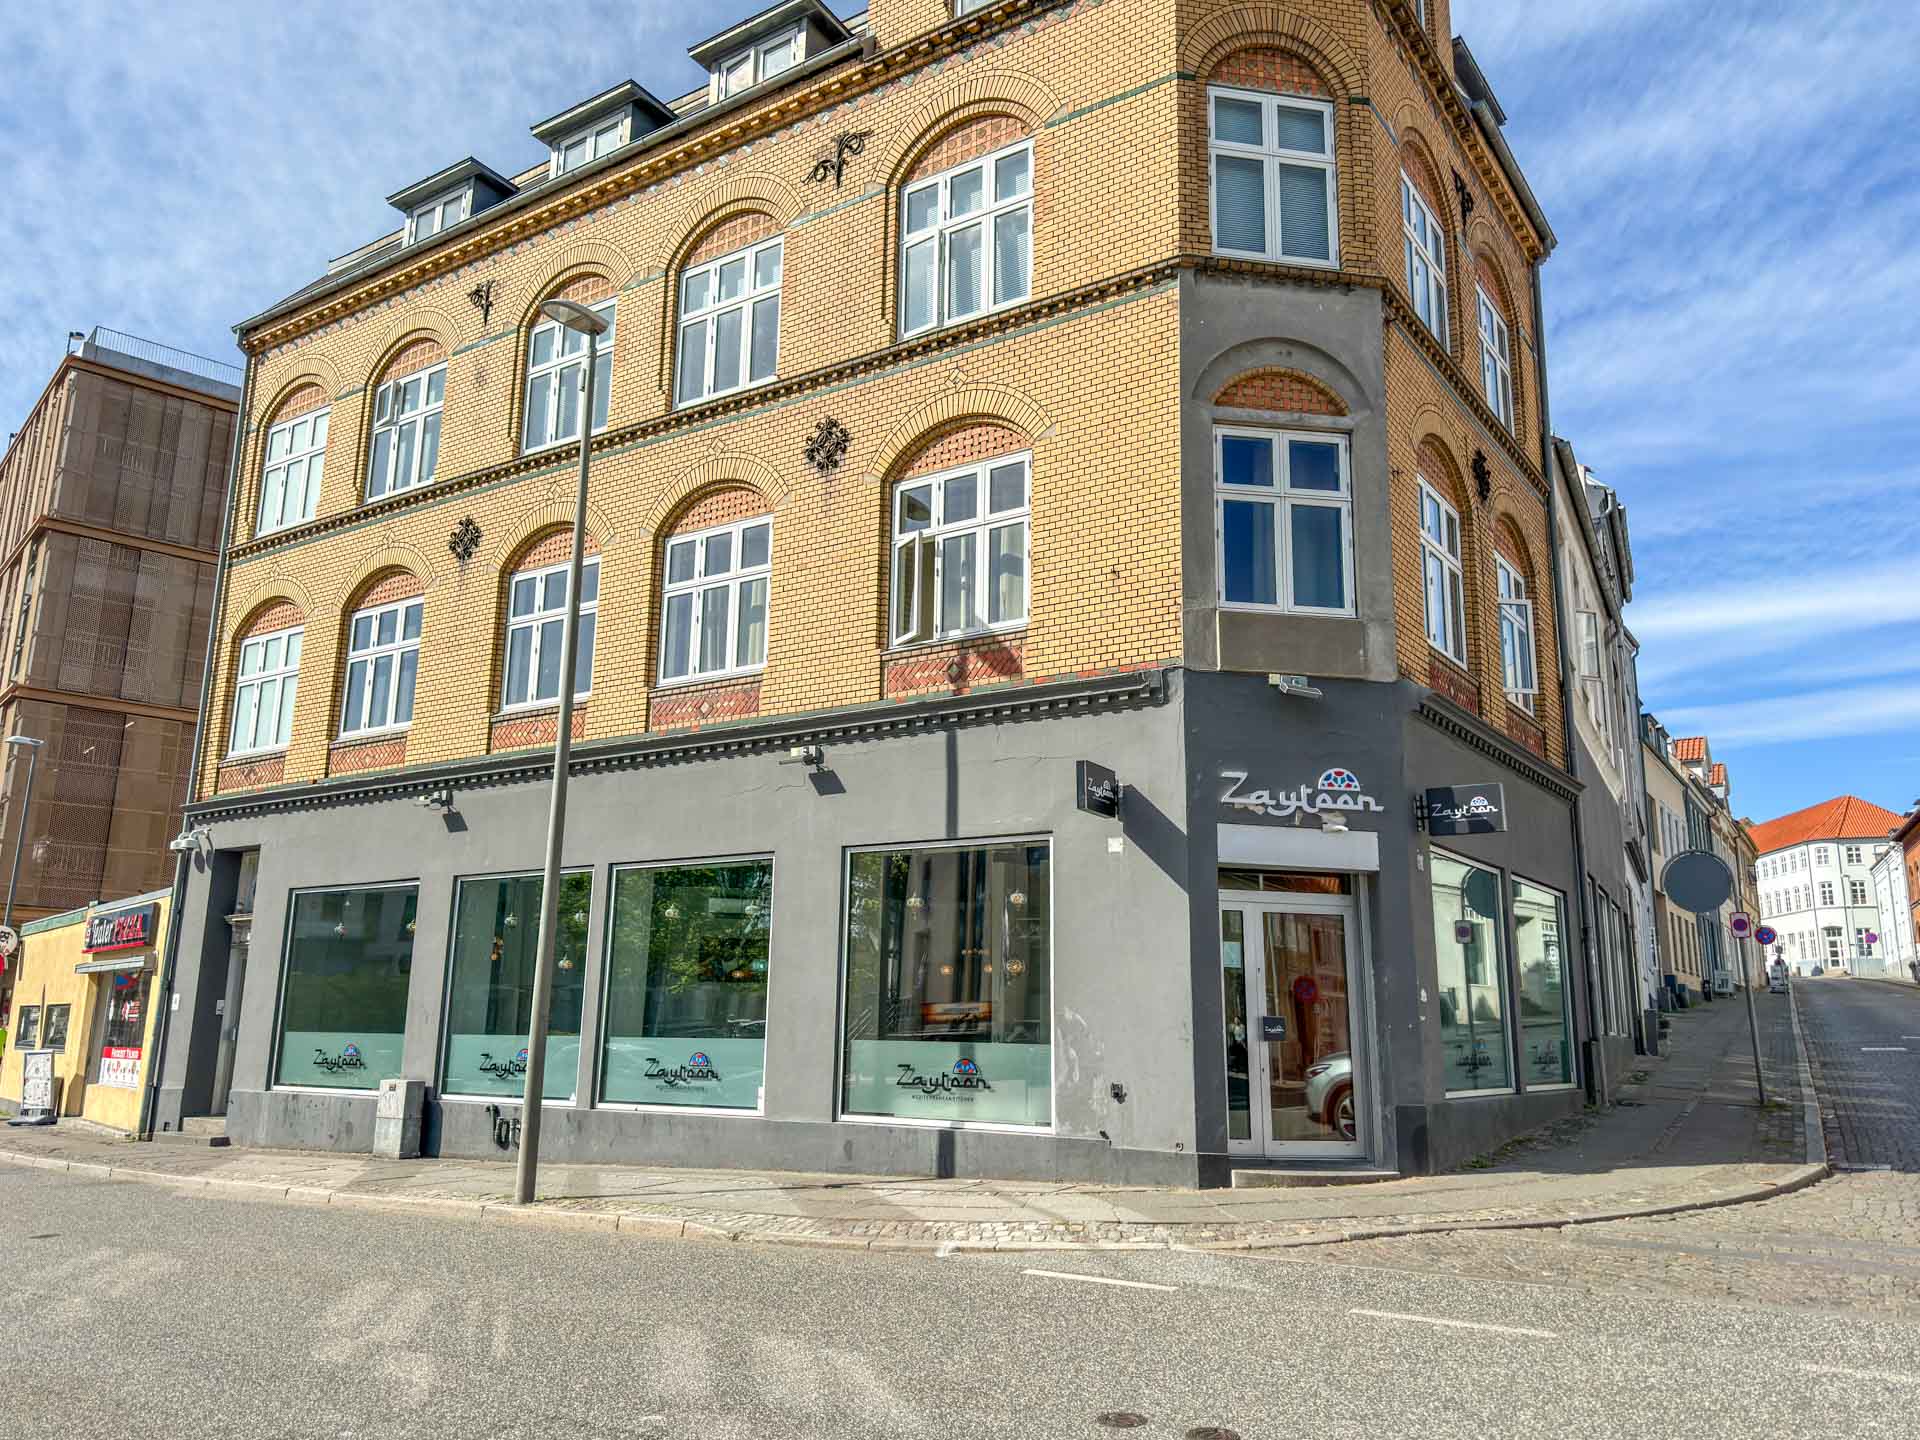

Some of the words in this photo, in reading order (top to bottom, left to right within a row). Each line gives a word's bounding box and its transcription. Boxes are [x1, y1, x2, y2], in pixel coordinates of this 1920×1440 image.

[1087, 777, 1115, 799] Zaytoon
[1220, 771, 1385, 817] Zaytoon
[1431, 803, 1499, 819] Zaytoon
[92, 919, 114, 945] Teater
[313, 1048, 366, 1071] Zaytoon
[644, 1057, 719, 1084] Zaytoon
[896, 1063, 992, 1094] Zaytoon
